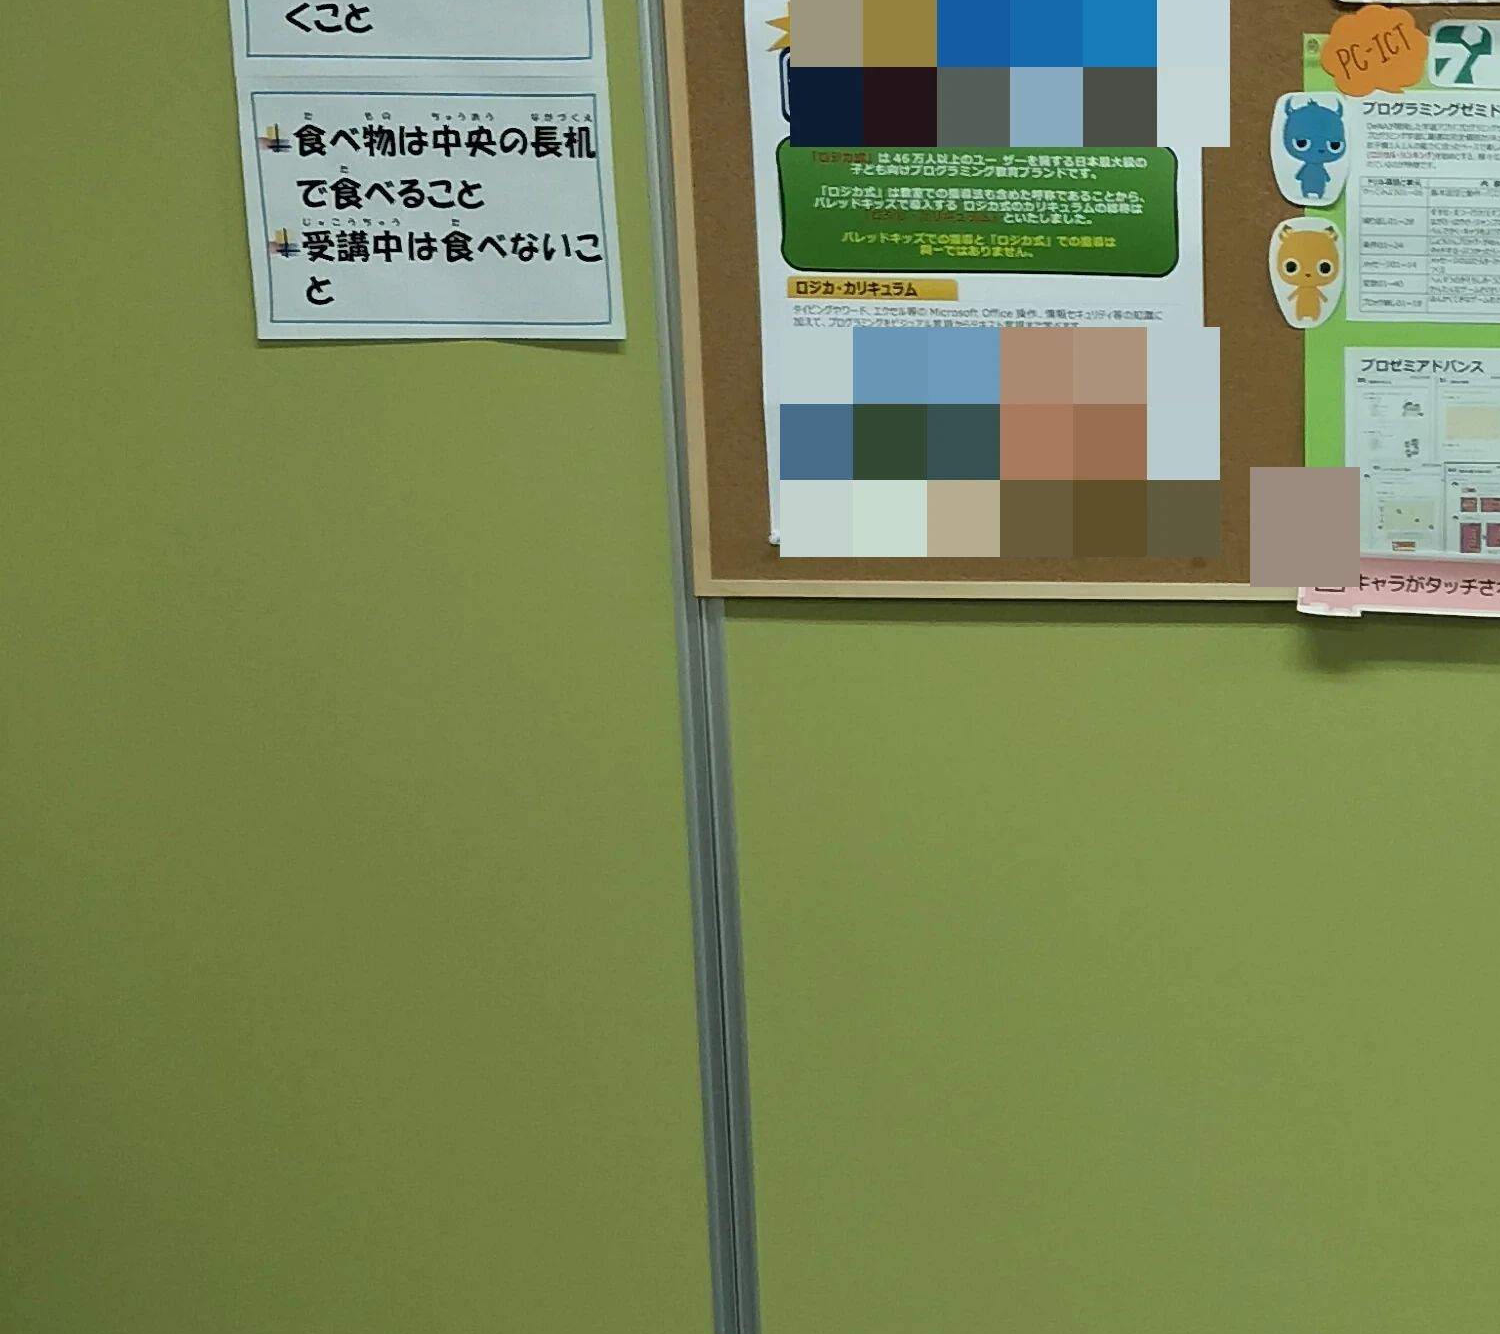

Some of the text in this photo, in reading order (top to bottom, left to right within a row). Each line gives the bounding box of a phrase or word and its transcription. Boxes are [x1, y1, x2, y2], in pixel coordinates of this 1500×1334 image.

[285, 2, 374, 33] くこと
[1336, 23, 1414, 80] PC-ICT
[293, 124, 597, 159] 食べ物は中央の長机
[296, 177, 486, 209] で食べること
[302, 231, 603, 263] 受講中は食べないこ
[306, 276, 335, 306] と
[795, 280, 919, 298] ロジカ・カリキュラム
[1361, 358, 1485, 373] プロゼミアドバンス
